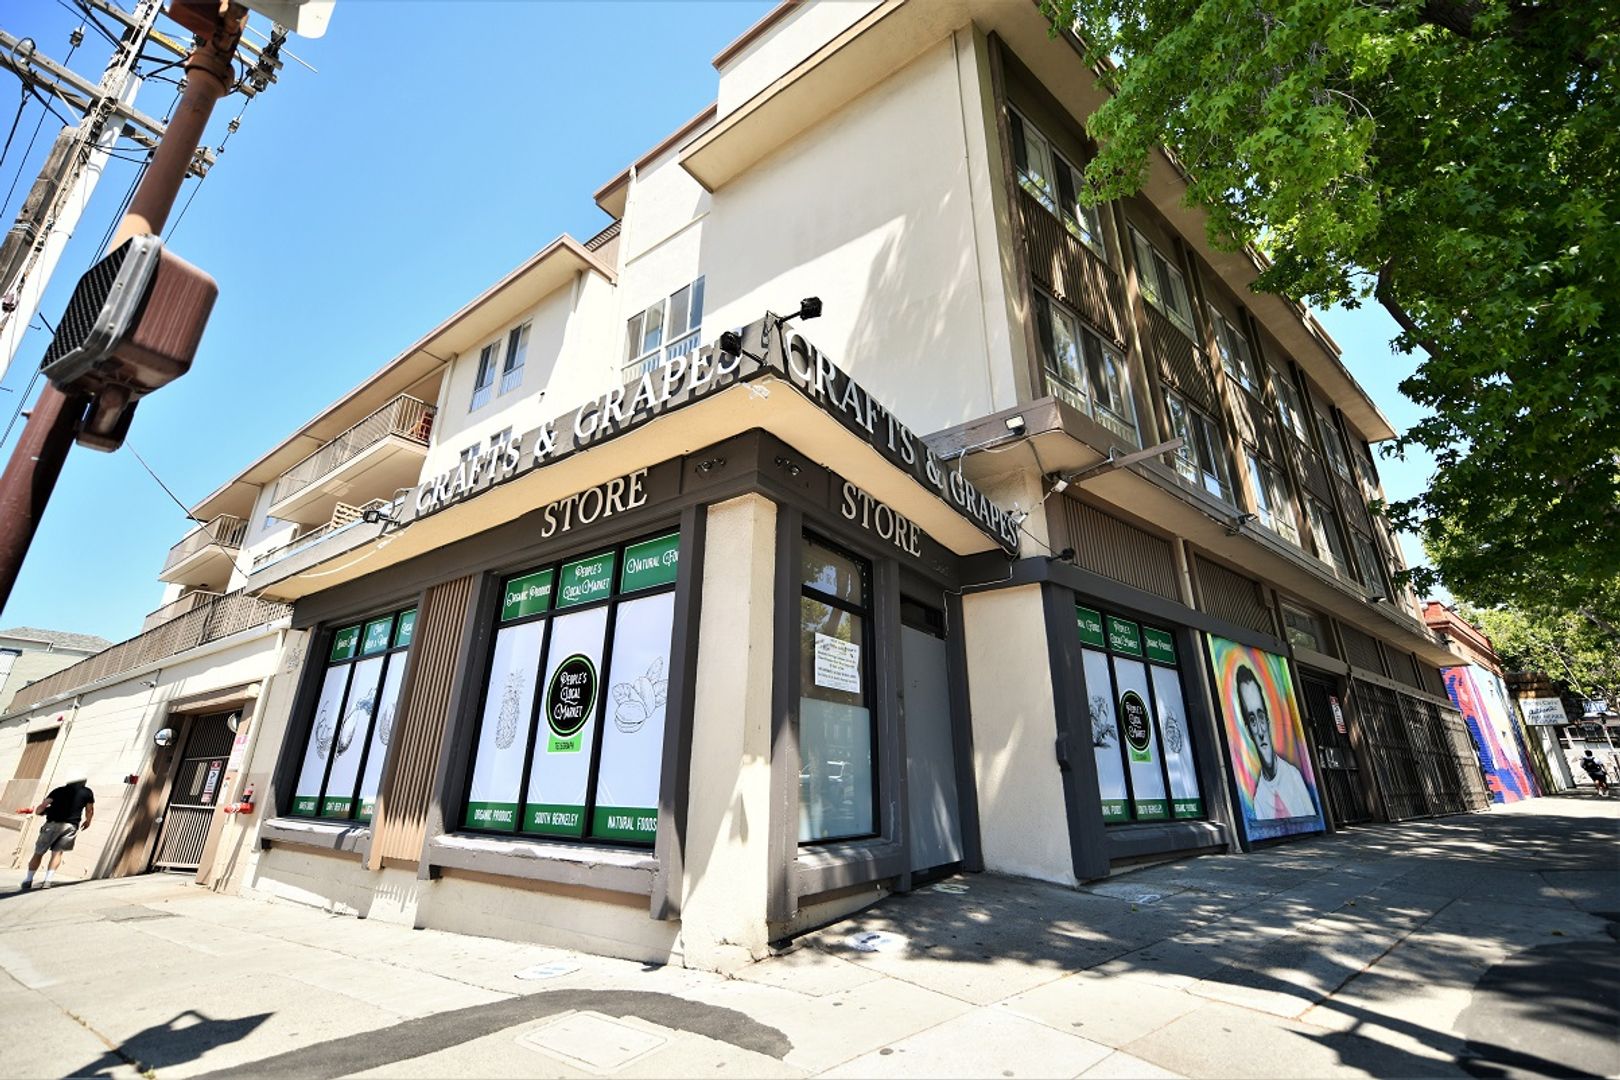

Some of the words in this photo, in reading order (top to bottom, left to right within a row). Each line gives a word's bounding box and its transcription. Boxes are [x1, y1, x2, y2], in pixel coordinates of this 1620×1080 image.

[785, 329, 915, 465] CRAFTS
[926, 449, 944, 490] &
[949, 470, 1018, 548] GRAPES
[416, 432, 522, 510] CRAFTS
[533, 419, 557, 457] &
[541, 467, 648, 537] STORE
[841, 482, 921, 557] STORE
[560, 671, 587, 688] PEOPLE'S
[493, 810, 512, 823] PRODUCE
[534, 811, 550, 824] SOUTH
[552, 812, 579, 826] BERKELEY
[608, 815, 634, 831] NATURAL
[636, 817, 657, 832] FOODS
